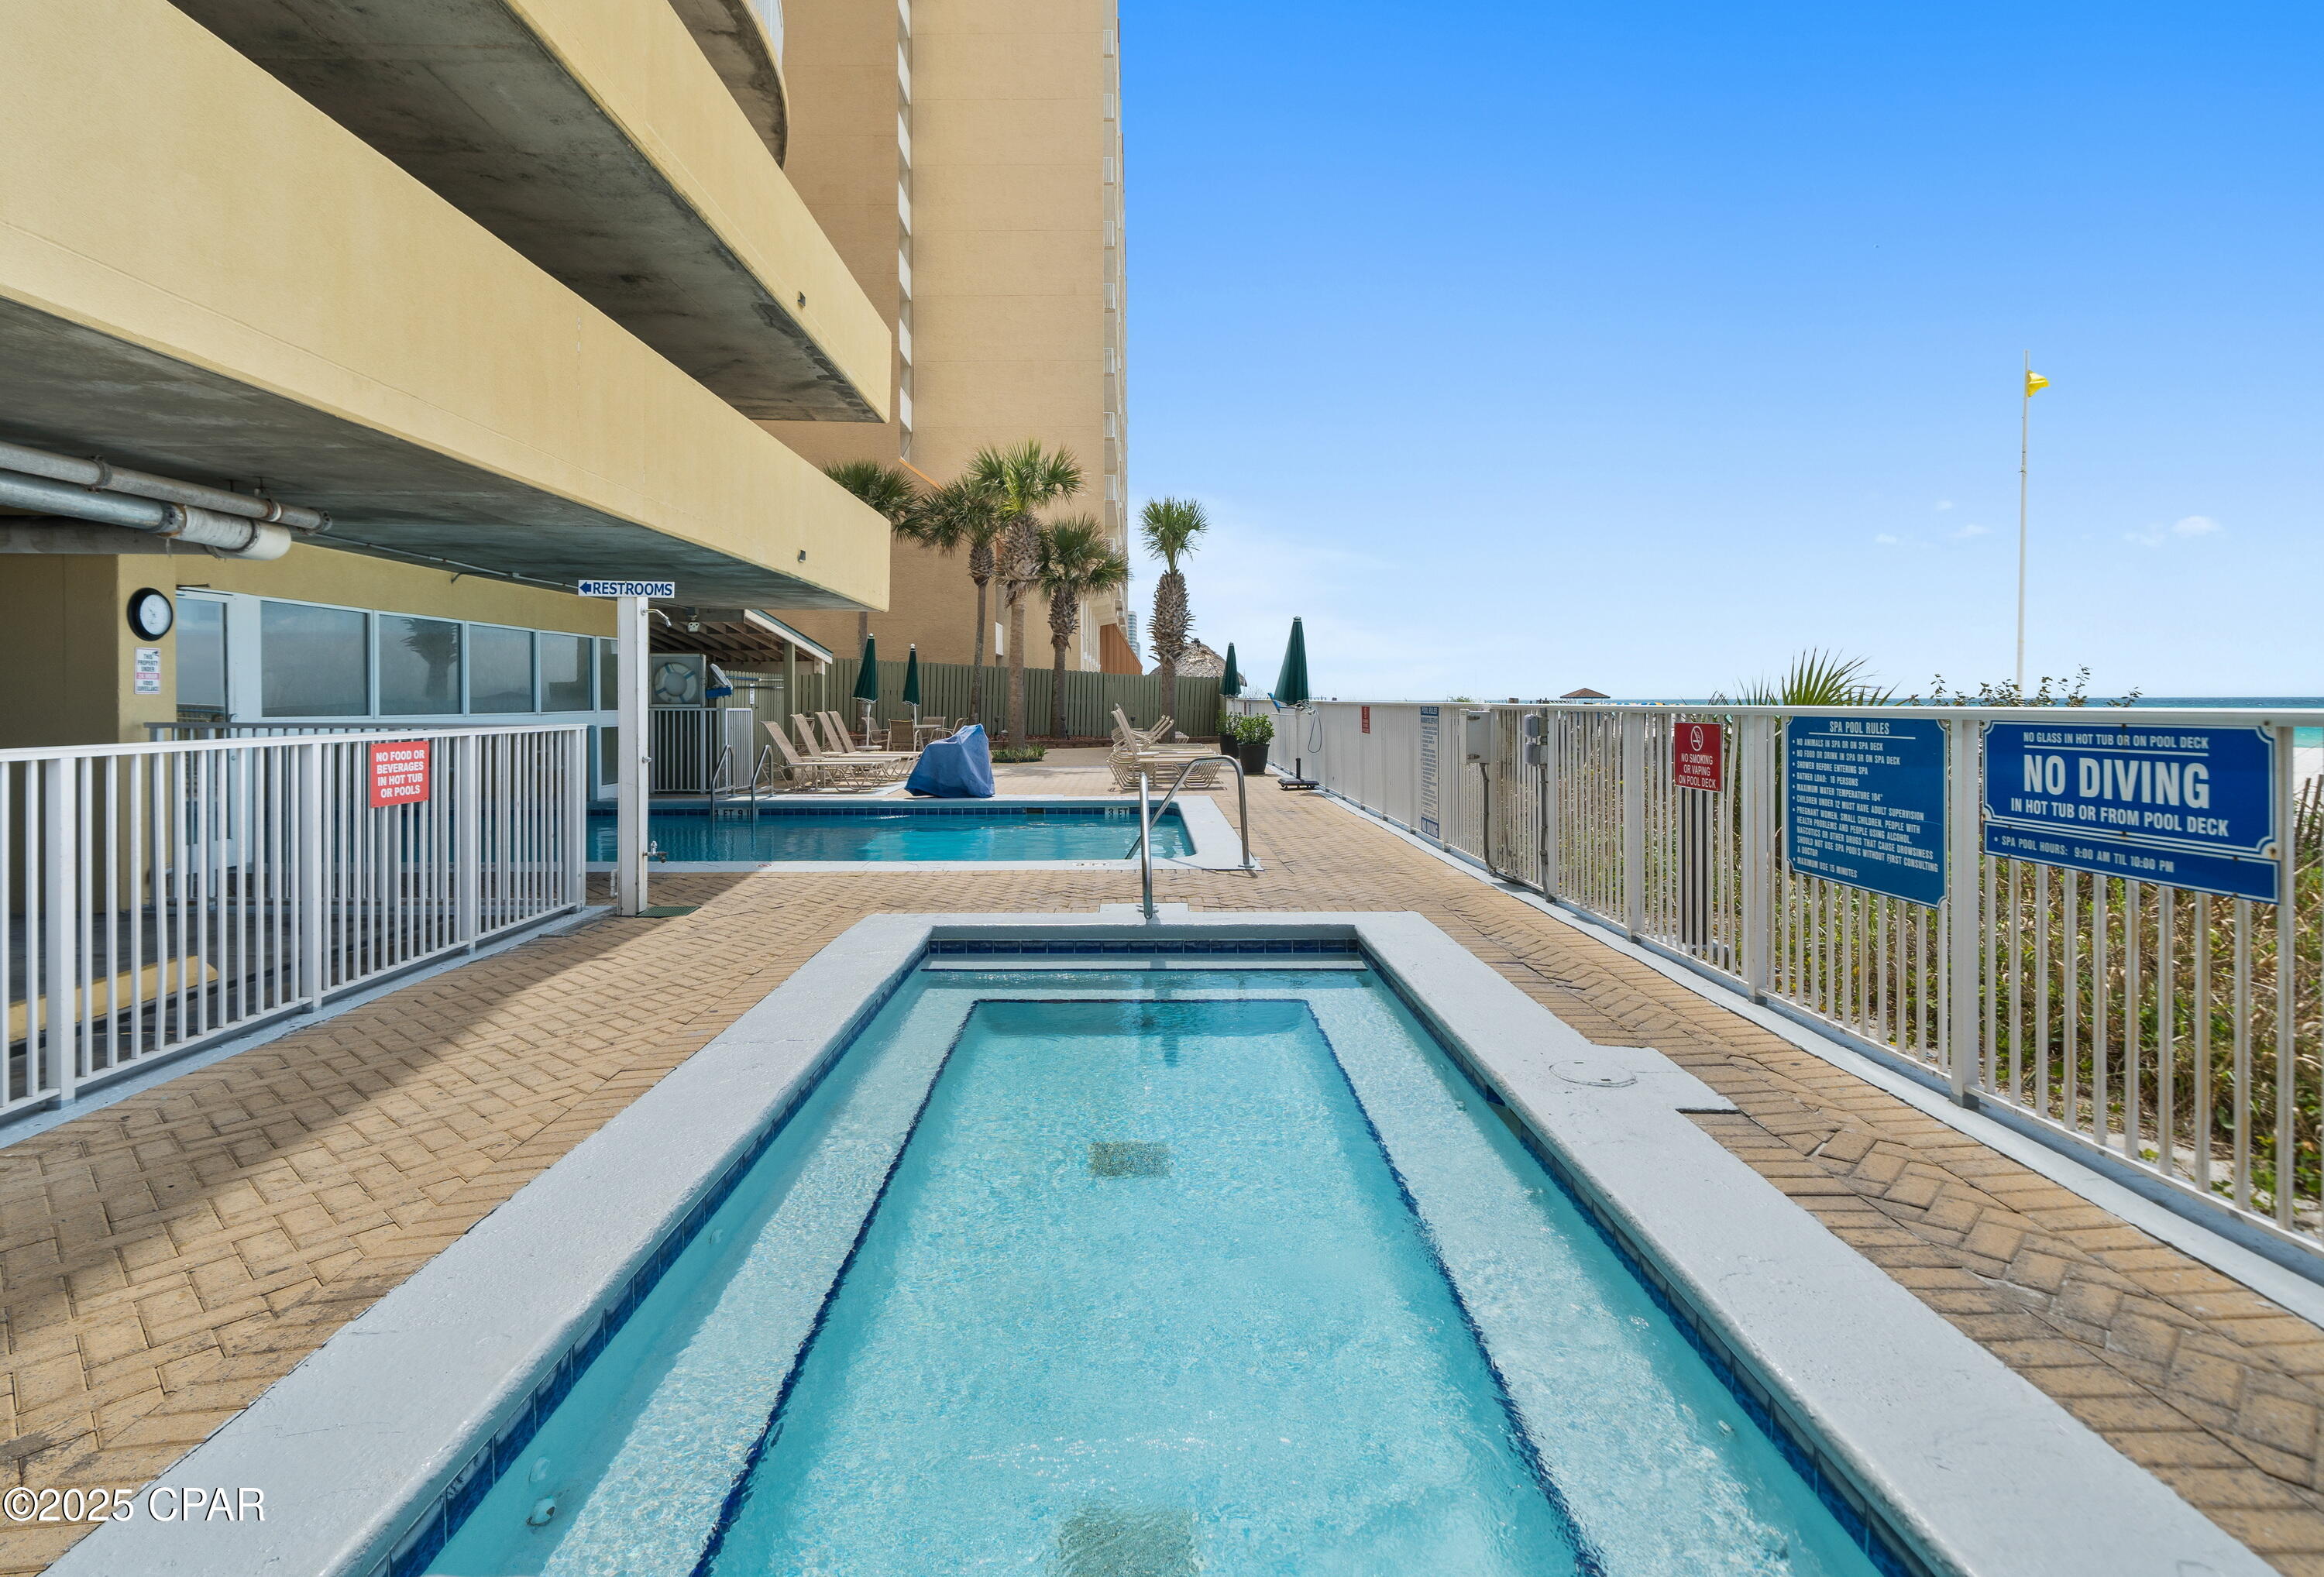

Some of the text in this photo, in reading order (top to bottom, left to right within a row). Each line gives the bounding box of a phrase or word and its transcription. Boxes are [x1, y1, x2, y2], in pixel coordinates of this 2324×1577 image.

[593, 582, 672, 596] RESTROOMS
[1829, 721, 1889, 735] SPA POOL RULES
[1804, 739, 1824, 747] ANIMALS
[1870, 742, 1883, 751] DECK
[2023, 732, 2209, 749] NO GLASS IN HOT TUB OR ON POOL DECK
[376, 750, 425, 762] NO FOOD OR
[1681, 754, 1713, 765] NO SMOKING
[1804, 750, 1815, 758] FOOD
[1824, 751, 1838, 760] DRINK
[1846, 753, 1856, 761] SPA
[1857, 754, 1864, 762] OR
[1865, 754, 1873, 763] ON
[1875, 755, 1885, 764] SPA
[1886, 756, 1900, 765] DECK
[376, 761, 424, 775] BEVERAGES
[1683, 764, 1710, 776] OR VAPING
[1816, 762, 1832, 771] BEFORE
[1834, 764, 1857, 774] ENTERING
[1858, 766, 1868, 775] SPA
[377, 773, 423, 786] IN HOT TUB
[1679, 775, 1716, 788] ON POOL DECK
[1797, 772, 1813, 781] BATHER
[1837, 776, 1858, 786] PERSONS
[2023, 754, 2209, 809] NO DIVING
[380, 785, 421, 798] OR POOLS
[1797, 784, 1818, 793] MAXIMUM
[1819, 786, 1834, 795] WATER
[1836, 788, 1870, 800] TEMPERATURE
[1797, 795, 1817, 805] CHILDREN
[1818, 798, 1834, 807] UNDER
[1841, 801, 1855, 810] MUST
[1856, 803, 1869, 813] HAVE
[1871, 806, 1887, 815] ADULT
[1889, 808, 1924, 821] SUPERVISION
[1797, 806, 1819, 816] PREGNANT
[1840, 813, 1856, 823] SMALL
[1885, 819, 1904, 831] PEOPLE
[1906, 823, 1920, 834] WITH
[2010, 798, 2229, 837] IN HOT TUB OR FROM POOL DECK
[1797, 816, 1813, 826] HEALTH
[1813, 819, 1838, 830] PROBLEMS
[1838, 823, 1848, 832] AND
[1850, 825, 1868, 836] PEOPLE
[1869, 829, 1885, 839] USING
[1801, 846, 1818, 857] DOCTOR
[1822, 830, 1828, 839] OR
[1830, 832, 1844, 842] OTHER
[1846, 835, 1862, 846] DRUGS
[1863, 838, 1876, 848] THAT
[1878, 841, 1895, 852] CAUSE
[1896, 844, 1933, 860] DROWSINESS
[1797, 835, 1938, 873] SHOULD NOT USE SPA POOLS WITHOUT FIRST CONSULTING
[2001, 836, 2174, 873] SPA POOL HOURS: 9:00 AM TIL 10:00 PM
[1797, 857, 1858, 878] MAXIMUM USE 15 MINUTES
